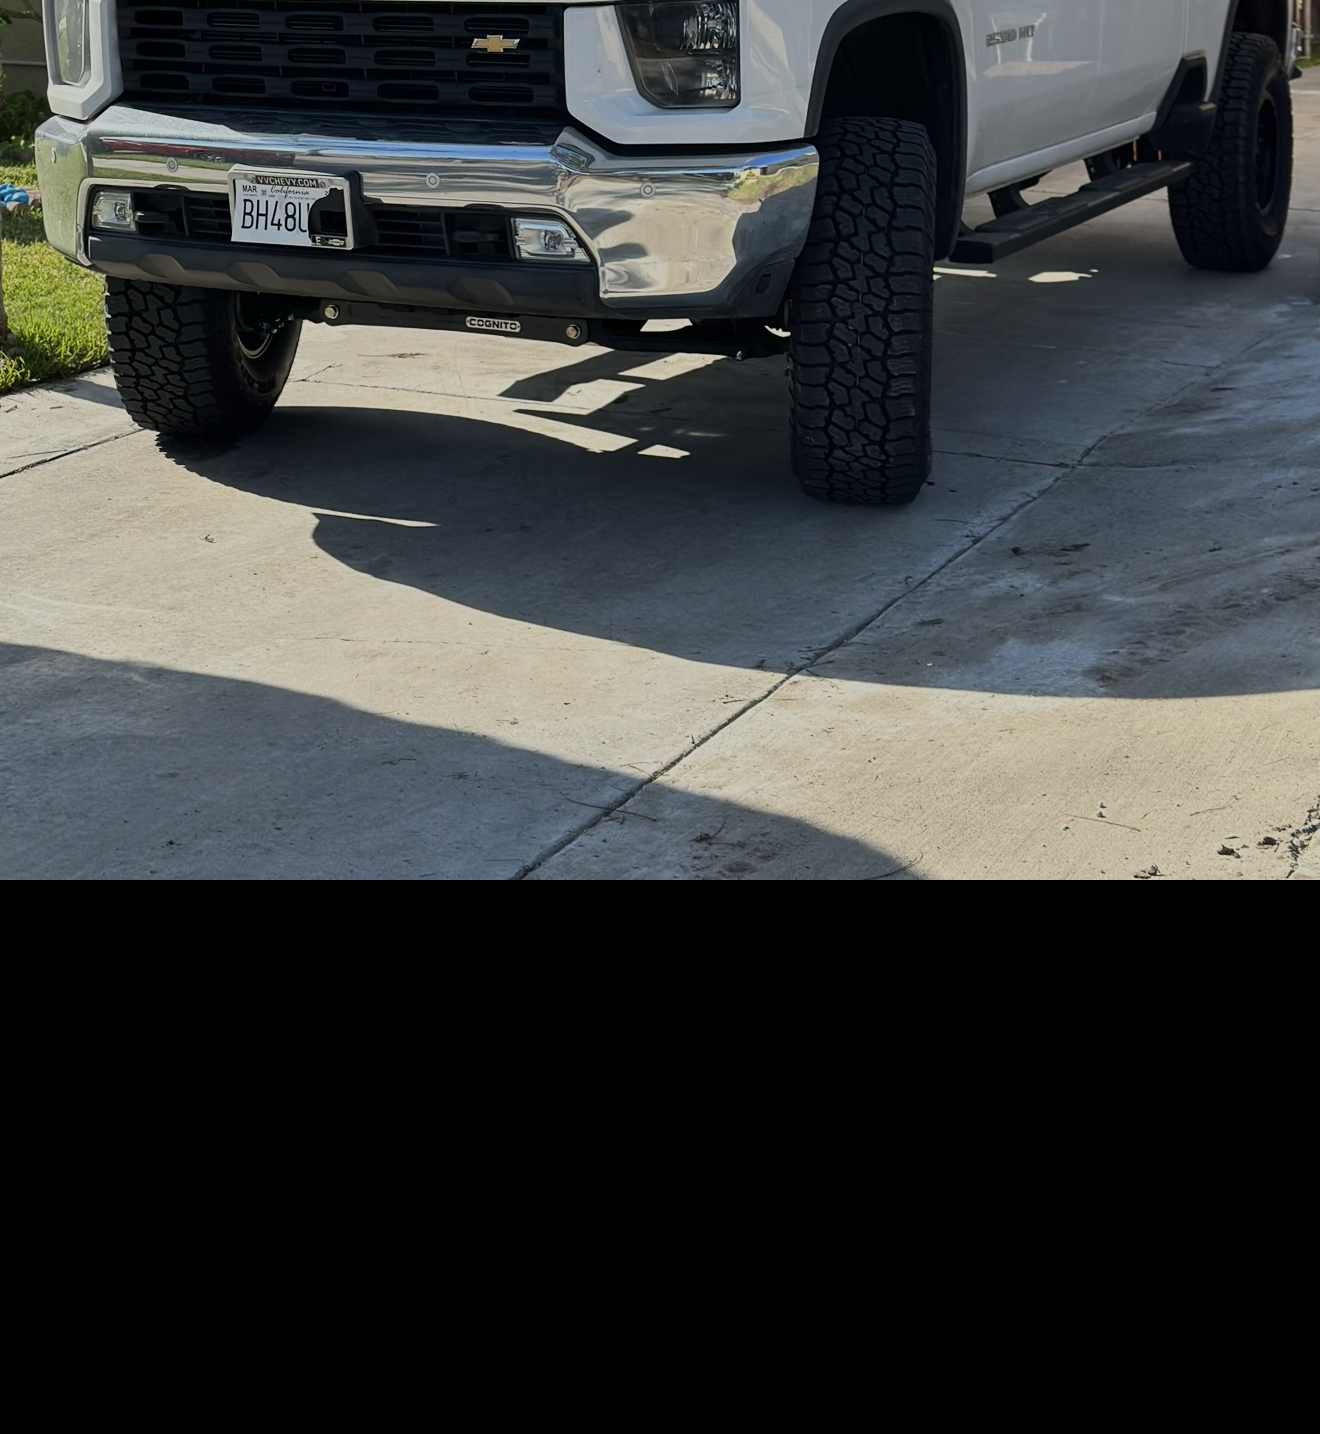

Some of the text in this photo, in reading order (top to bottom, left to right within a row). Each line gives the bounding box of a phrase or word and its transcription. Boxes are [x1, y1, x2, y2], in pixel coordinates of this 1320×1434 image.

[257, 176, 317, 187] VVCHEVY.COM
[242, 184, 258, 193] MAR
[270, 185, 309, 197] California
[469, 318, 517, 330] COGNITO
